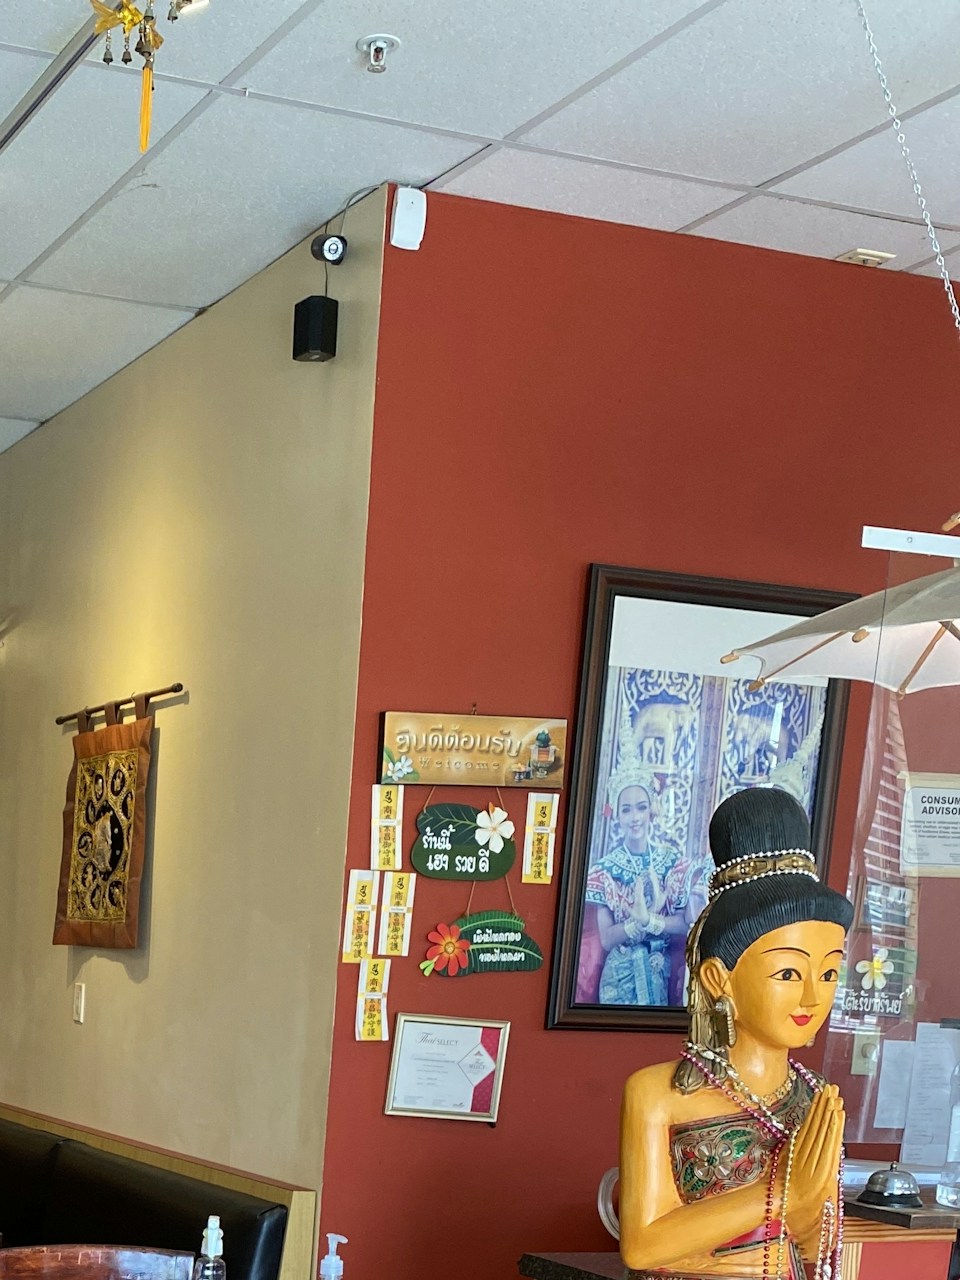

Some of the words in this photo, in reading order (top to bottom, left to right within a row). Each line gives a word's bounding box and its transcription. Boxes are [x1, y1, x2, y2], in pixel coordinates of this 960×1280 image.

[396, 724, 522, 758] ยินดีต้อนรับ
[419, 755, 501, 770] Welcome
[921, 795, 960, 805] CONSUM
[922, 806, 960, 816] ADVISO
[422, 824, 456, 850] ร้านนี้
[437, 1038, 459, 1047] SELECT
